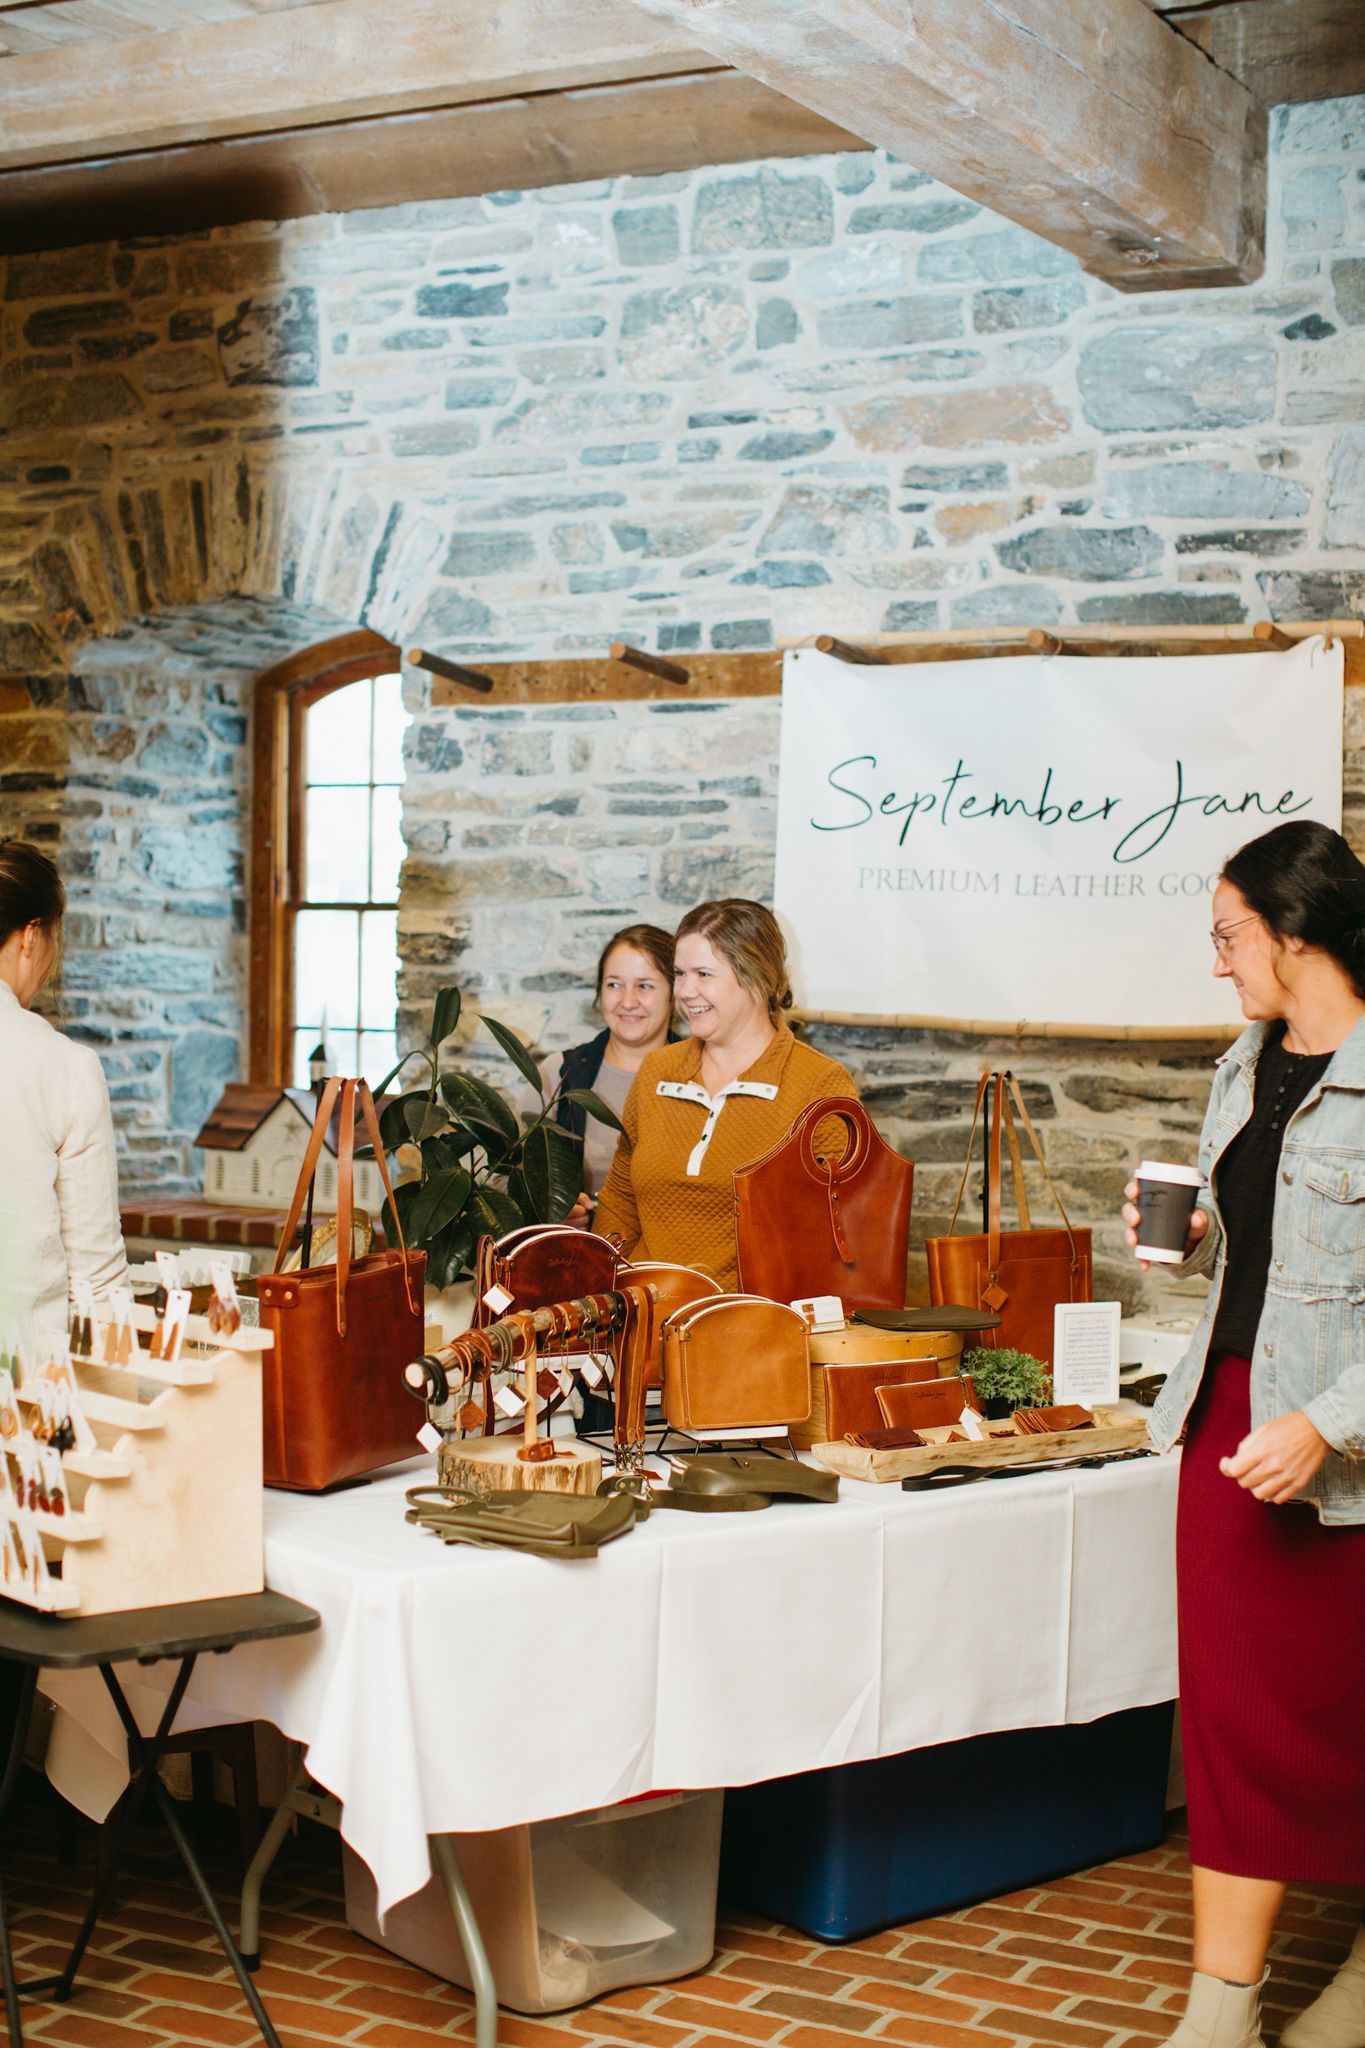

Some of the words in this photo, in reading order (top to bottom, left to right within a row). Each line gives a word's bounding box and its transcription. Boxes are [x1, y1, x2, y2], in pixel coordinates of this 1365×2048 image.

[811, 756, 1123, 847] September
[1113, 760, 1313, 863] Jane
[857, 866, 1000, 895] PREMIUM
[1014, 872, 1147, 897] LEATHER
